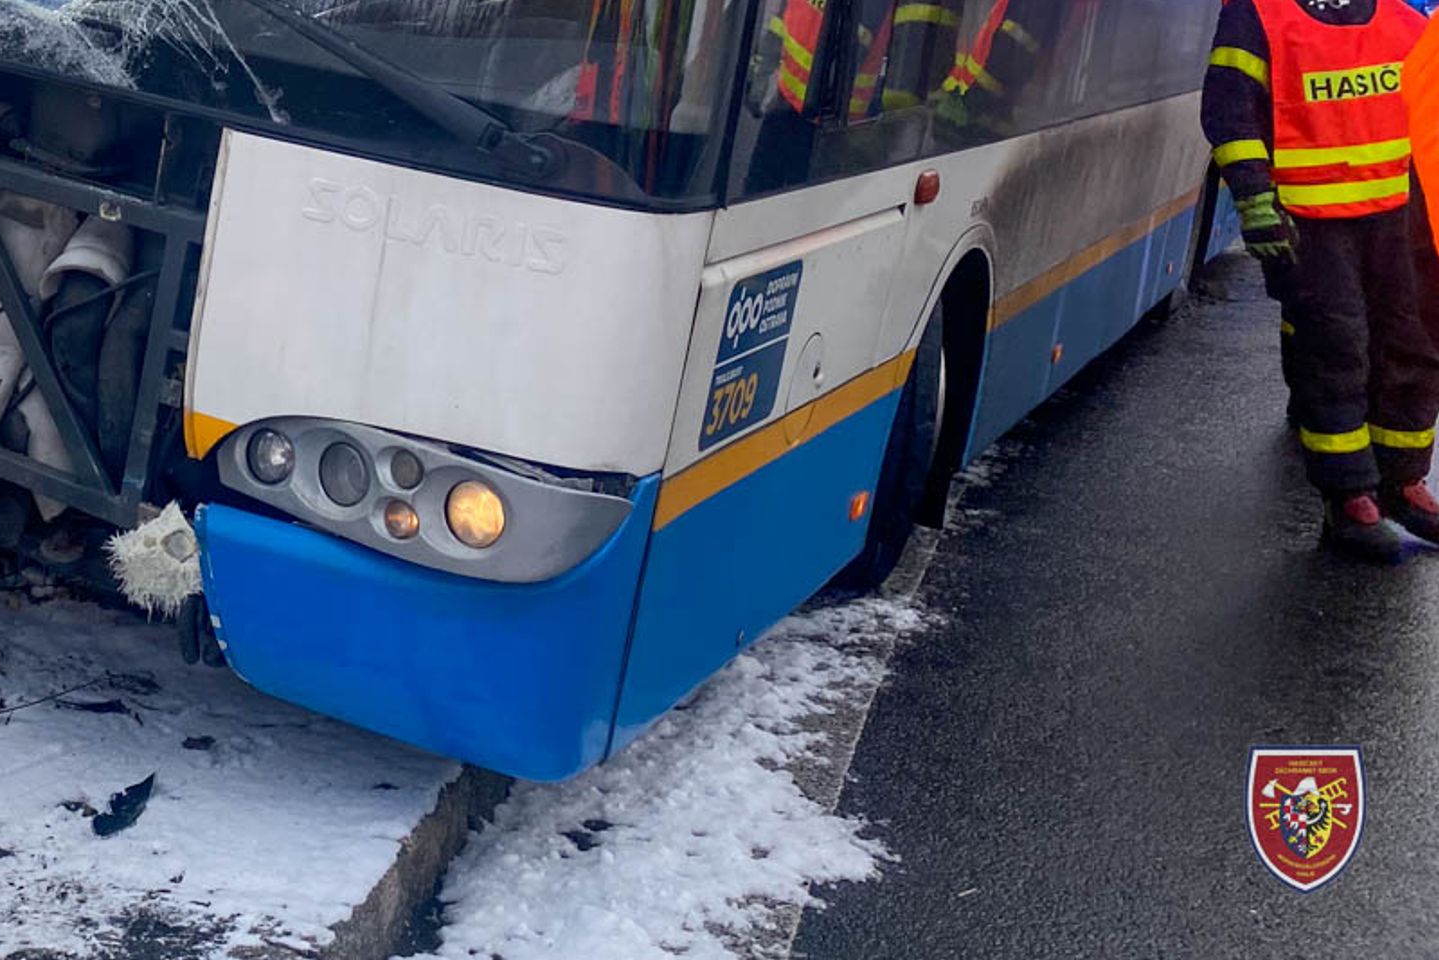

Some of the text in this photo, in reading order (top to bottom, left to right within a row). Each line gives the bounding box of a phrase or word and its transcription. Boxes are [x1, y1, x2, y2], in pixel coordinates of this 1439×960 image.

[1309, 64, 1403, 100] HASIČ
[302, 177, 566, 275] SOLARIS
[706, 371, 758, 436] 3709
